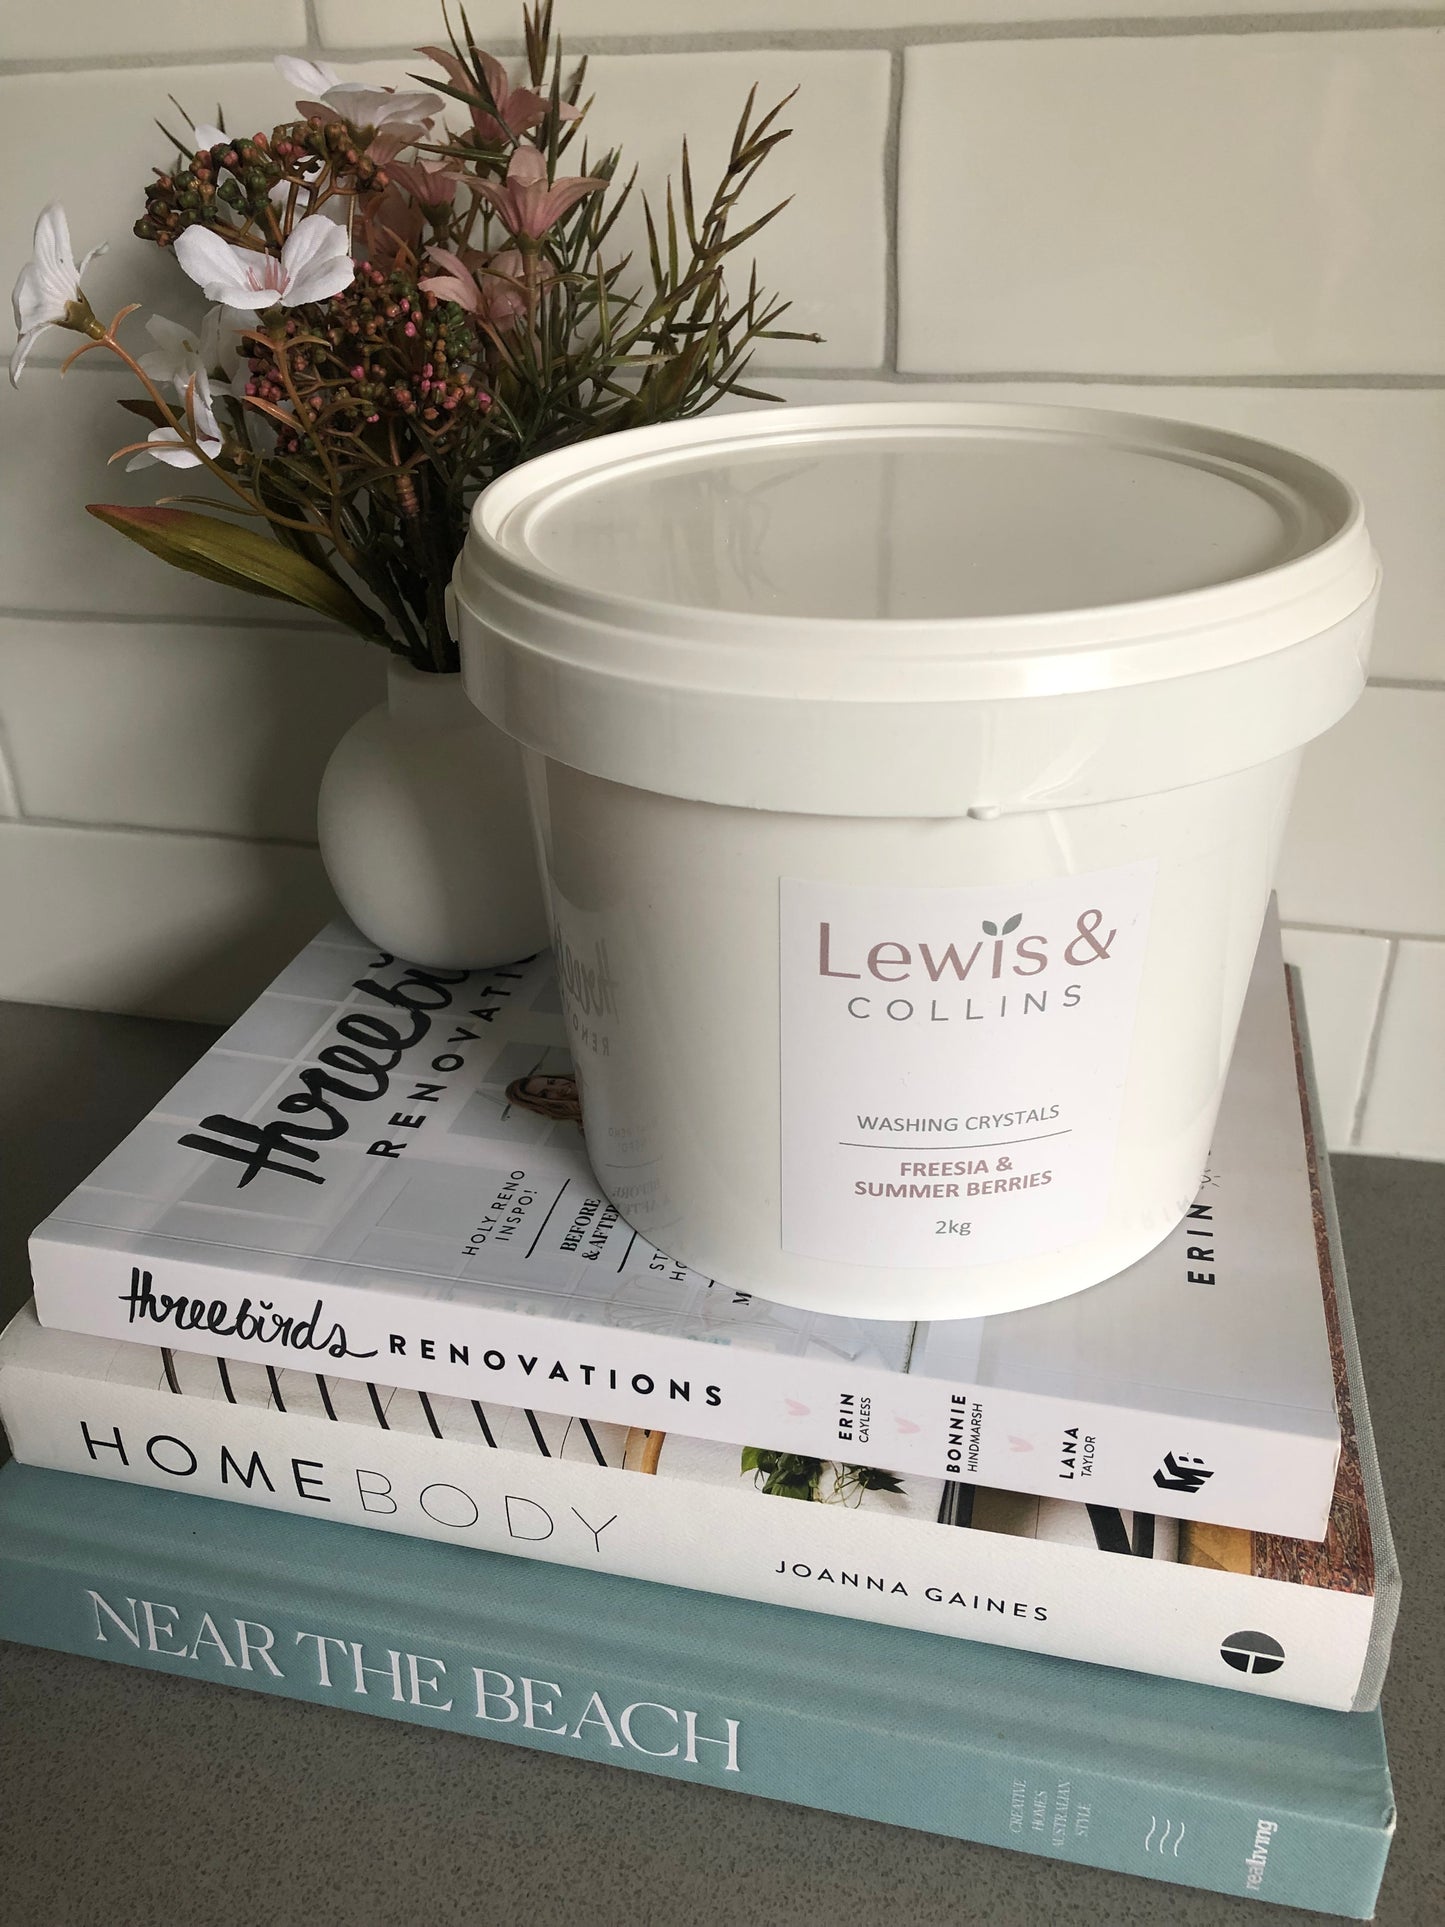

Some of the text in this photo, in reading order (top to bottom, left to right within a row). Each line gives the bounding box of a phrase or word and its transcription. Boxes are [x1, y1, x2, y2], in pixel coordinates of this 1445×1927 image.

[818, 908, 1117, 983] Lewis &
[847, 985, 1082, 1021] COLLINS
[365, 953, 539, 1159] RENOVATI
[857, 1104, 1060, 1132] WASHING CRYSTALS
[854, 1170, 1053, 1198] SUMMER BERRIES
[900, 1156, 1014, 1177] FREESIA &
[461, 1170, 526, 1256] HOLY RENO
[495, 1190, 538, 1241] INSPO!
[560, 1198, 601, 1252] BEFORE
[935, 1219, 972, 1236] 2kg
[582, 1250, 601, 1261] &
[1186, 1203, 1216, 1286] ERIN
[390, 1333, 722, 1407] RENOVATIONS
[838, 1392, 855, 1441] ERIN
[858, 1396, 872, 1443] CAYLESS
[946, 1394, 967, 1474] BONNIE
[967, 1402, 983, 1473] HINDMARSH
[1059, 1426, 1080, 1480] LANA
[1081, 1435, 1097, 1477] TAYLOR
[776, 1560, 1050, 1623] JOANNA GAINES
[86, 1590, 742, 1772] NEAR THE BEACH
[1009, 1778, 1027, 1834] CREATIVE
[1032, 1790, 1048, 1832] HOMES
[1051, 1779, 1072, 1849] AUSTRALIAN
[1074, 1802, 1093, 1838] STYLE
